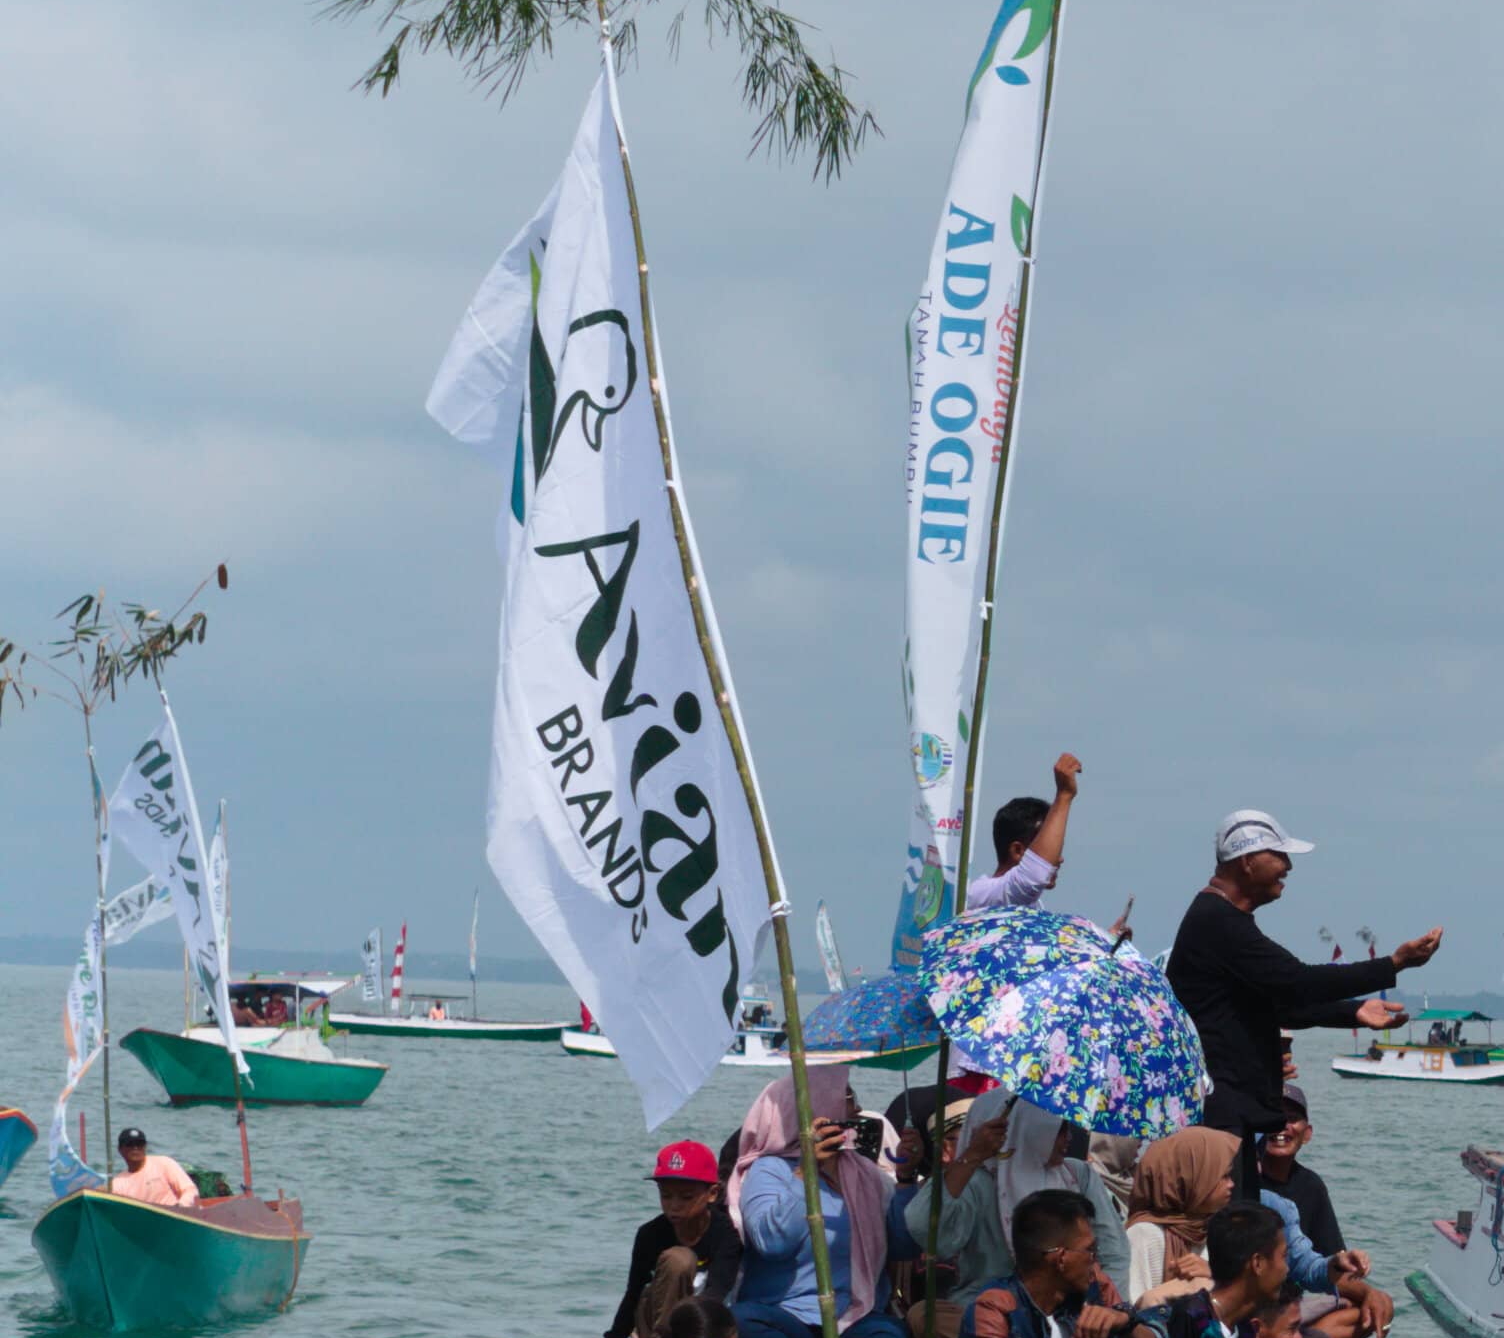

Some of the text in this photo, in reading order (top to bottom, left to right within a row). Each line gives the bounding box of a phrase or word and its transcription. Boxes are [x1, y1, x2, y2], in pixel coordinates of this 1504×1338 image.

[910, 290, 932, 388] TANAH
[916, 201, 996, 564] ADE OGIE
[533, 518, 741, 1030] Avian
[535, 703, 649, 946] BRANDS
